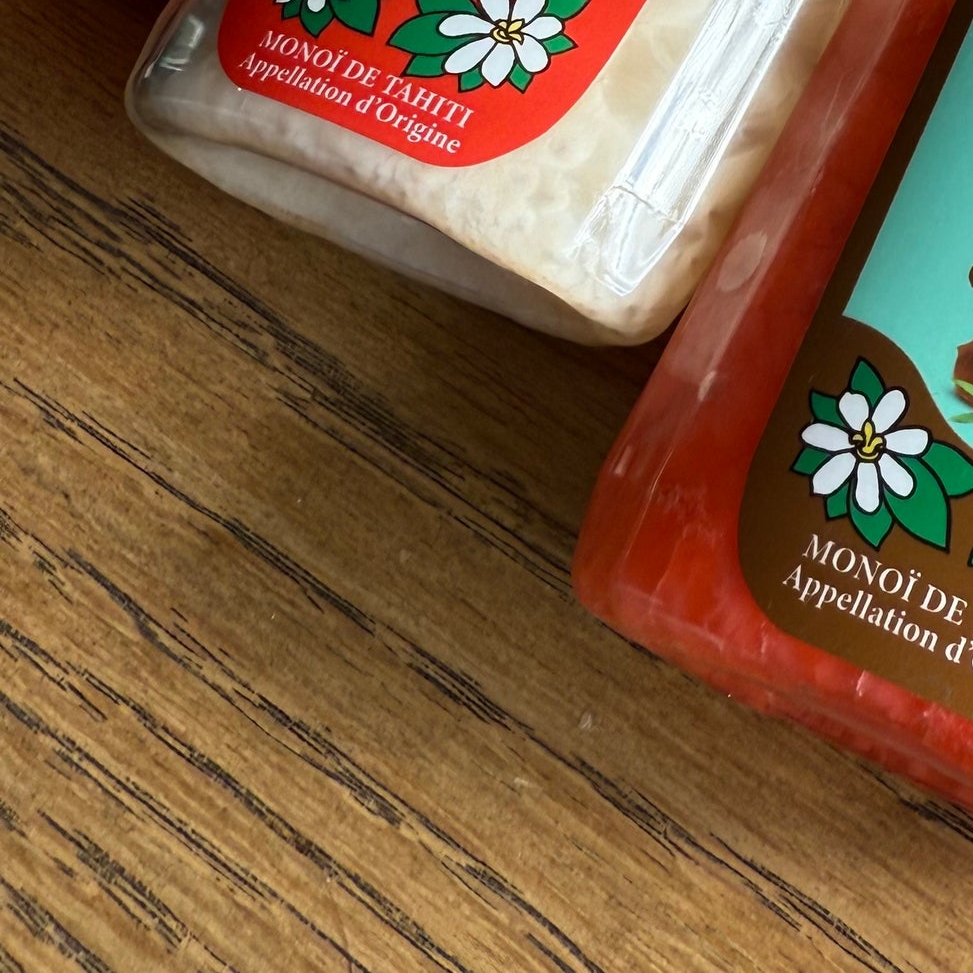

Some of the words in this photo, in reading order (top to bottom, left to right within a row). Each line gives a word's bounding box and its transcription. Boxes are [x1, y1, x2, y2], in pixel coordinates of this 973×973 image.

[239, 52, 353, 107] Appellation
[354, 94, 462, 155] d'Origine
[258, 30, 349, 73] MONOÏ
[341, 59, 382, 88] DE
[381, 74, 475, 129] TAHITI
[782, 564, 940, 653] Appellation
[801, 533, 923, 603] MONOÏ
[919, 584, 969, 627] DE
